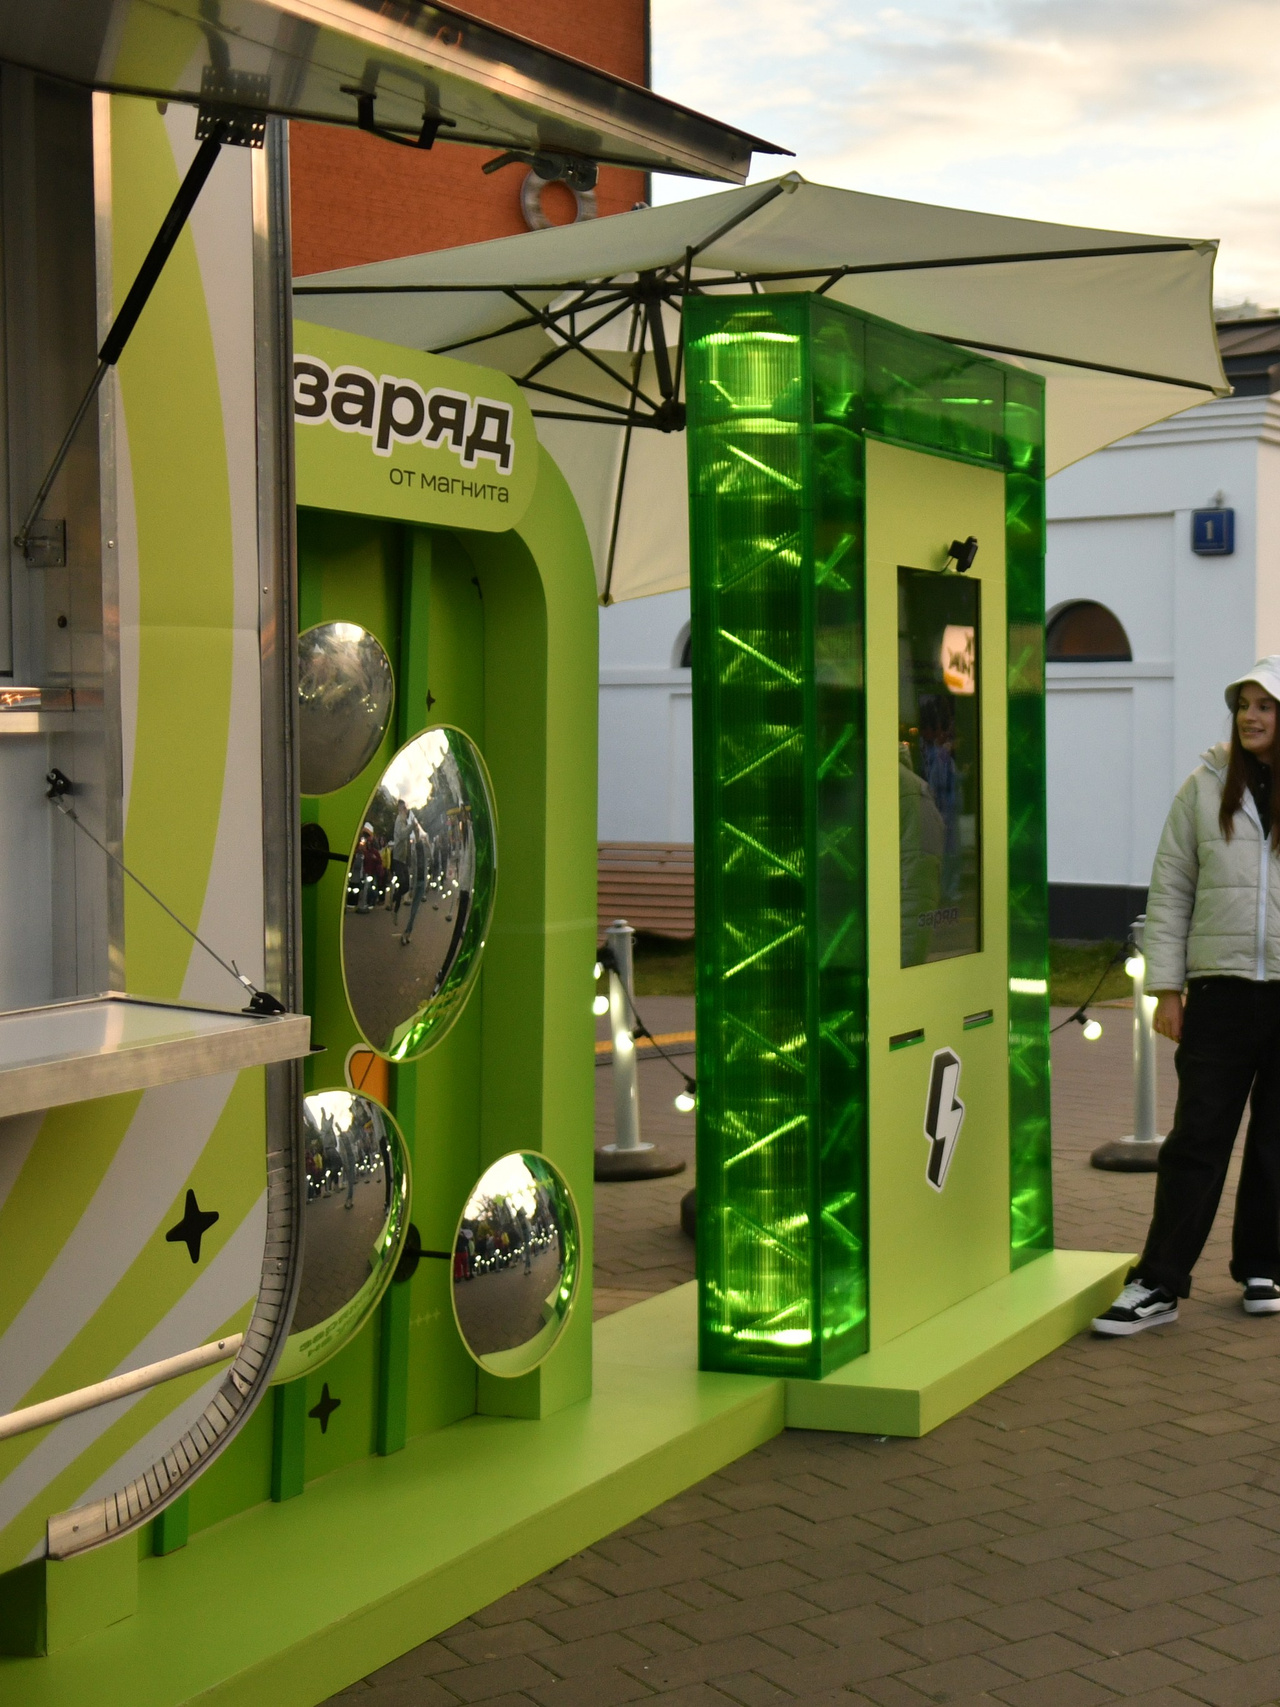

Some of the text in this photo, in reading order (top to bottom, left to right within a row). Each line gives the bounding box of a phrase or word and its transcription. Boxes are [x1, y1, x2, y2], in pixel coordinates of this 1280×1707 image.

[292, 359, 512, 470] заряд
[389, 468, 509, 504] от магнита
[1204, 519, 1214, 541] 1
[917, 905, 960, 930] заряд
